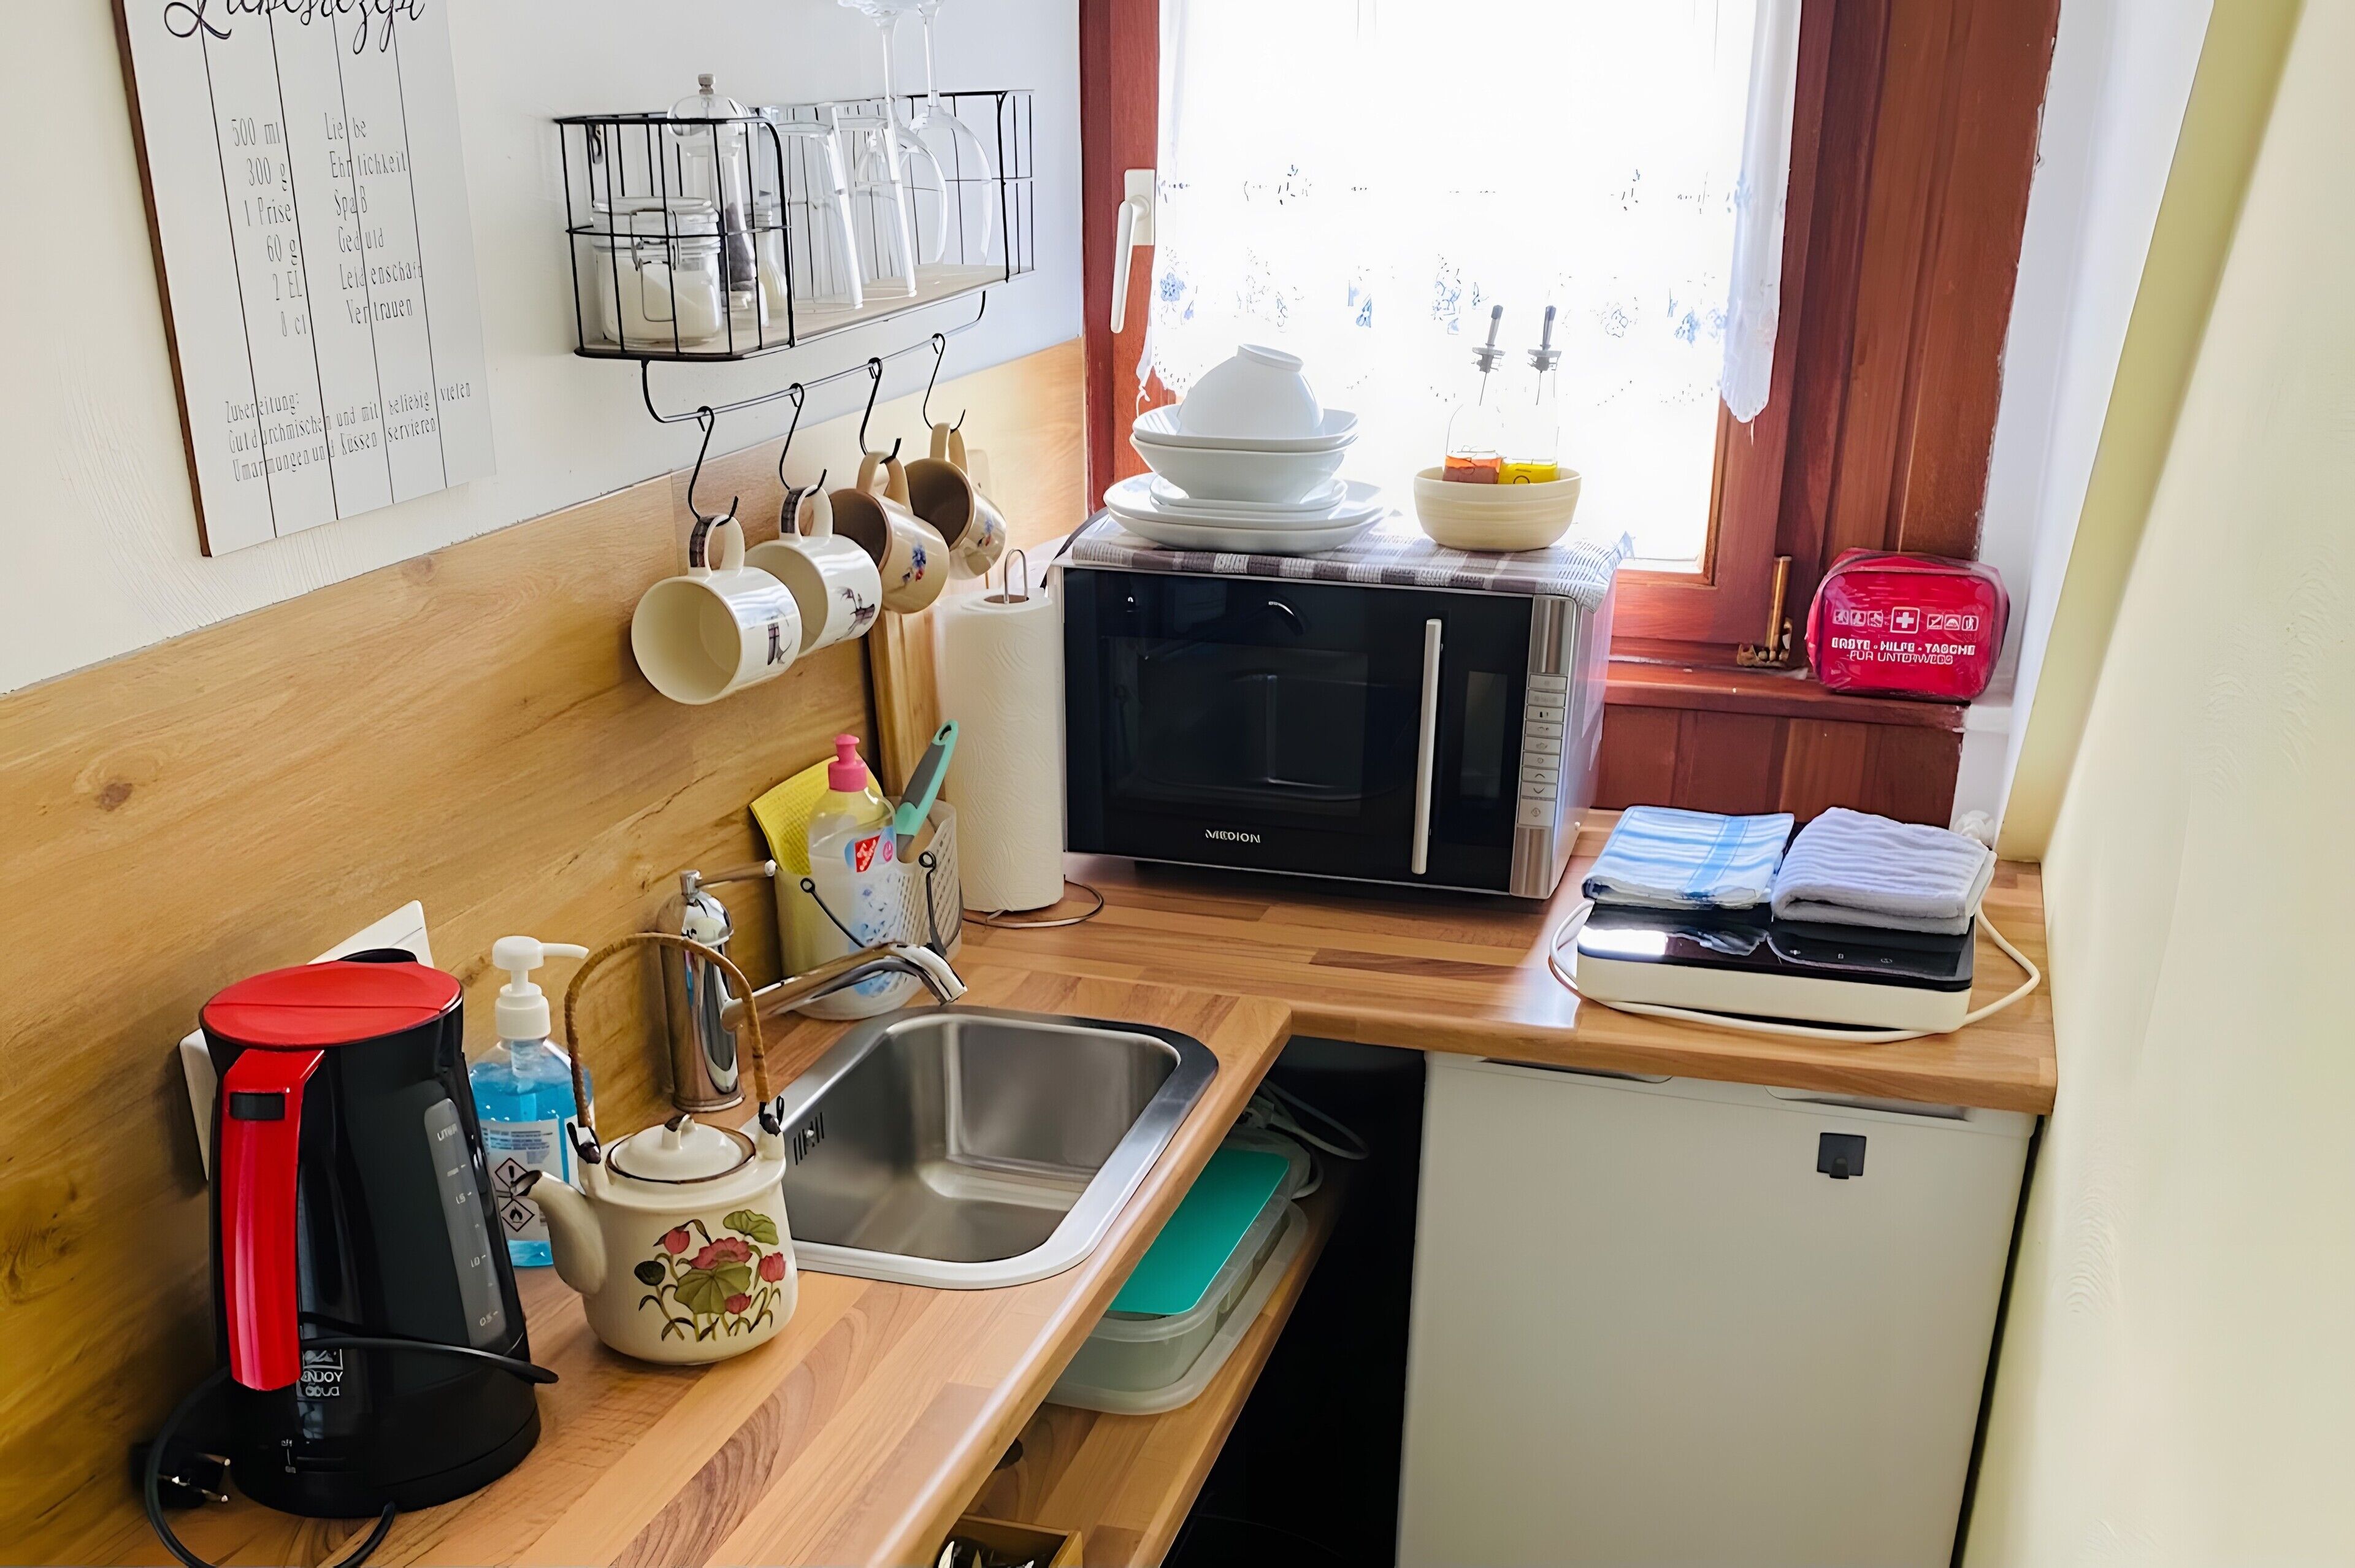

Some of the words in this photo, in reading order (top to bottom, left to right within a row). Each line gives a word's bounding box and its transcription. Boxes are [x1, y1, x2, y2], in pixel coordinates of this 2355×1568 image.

[231, 118, 256, 147] 500
[324, 112, 367, 140] Liebe
[247, 157, 271, 186] 300
[329, 150, 406, 178] Ehrlichkeit
[258, 197, 292, 225] Prise
[267, 234, 282, 262] 60
[338, 226, 384, 253] Geduld
[346, 299, 413, 324] Vertrauen
[336, 406, 356, 427] und
[1205, 829, 1261, 843] MEDION
